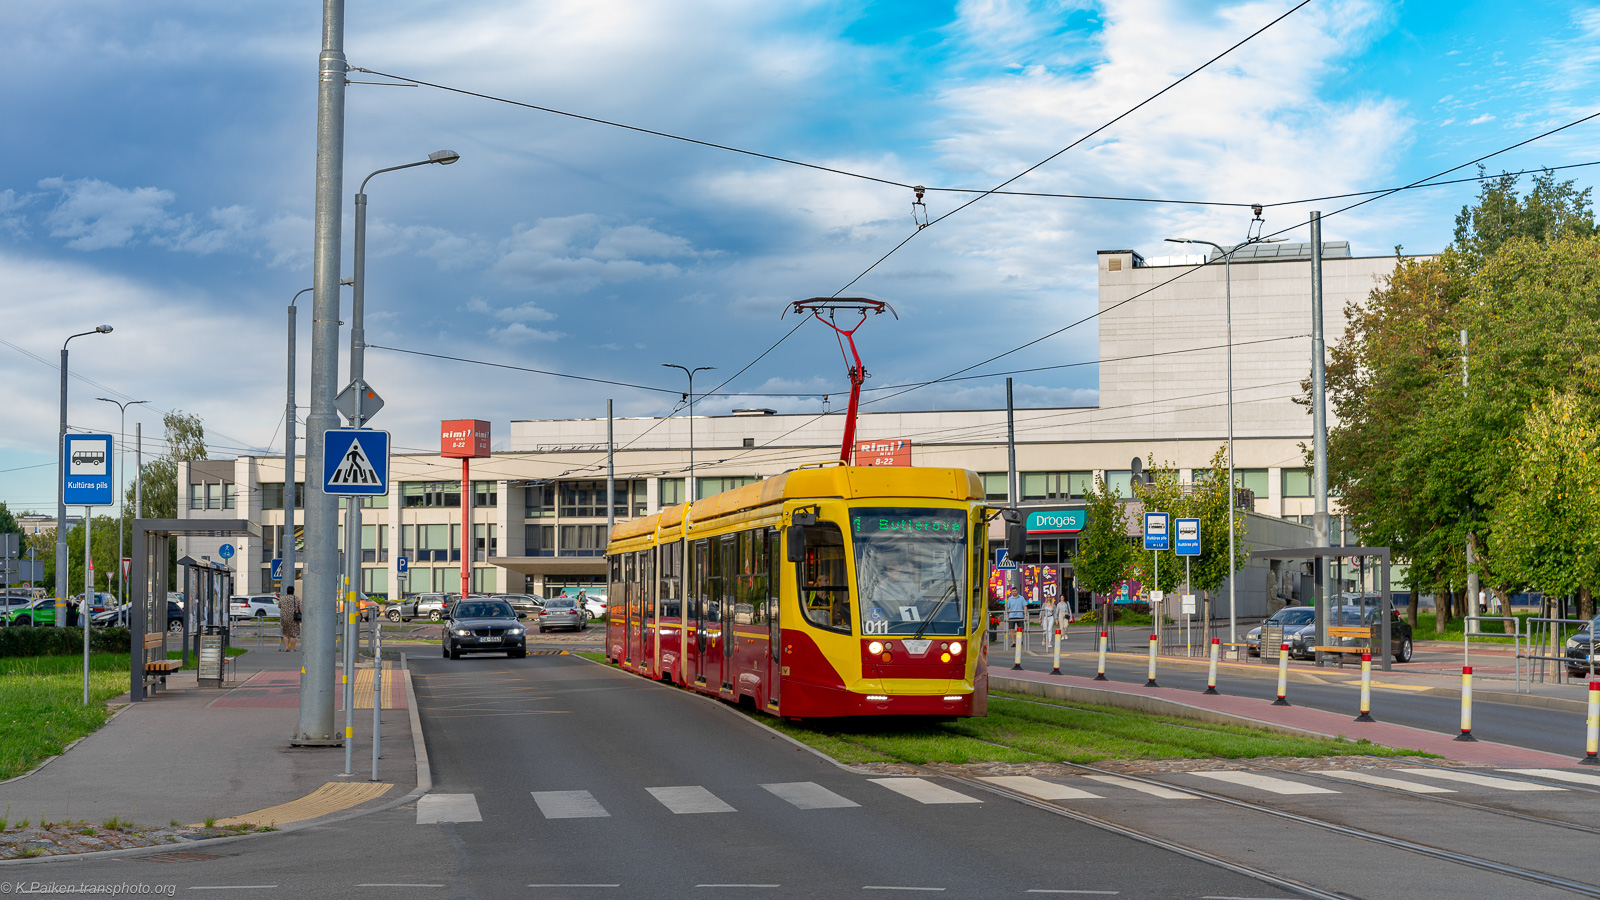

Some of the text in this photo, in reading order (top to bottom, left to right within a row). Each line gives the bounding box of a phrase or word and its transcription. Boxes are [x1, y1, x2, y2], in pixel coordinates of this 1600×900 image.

[861, 442, 895, 452] Rimi
[875, 457, 894, 465] 8-22
[67, 481, 108, 491] Kultūras pils
[1036, 515, 1076, 528] Drogas
[399, 558, 406, 571] P
[1043, 583, 1057, 598] 50
[904, 607, 915, 621] 1
[865, 620, 889, 634] 011
